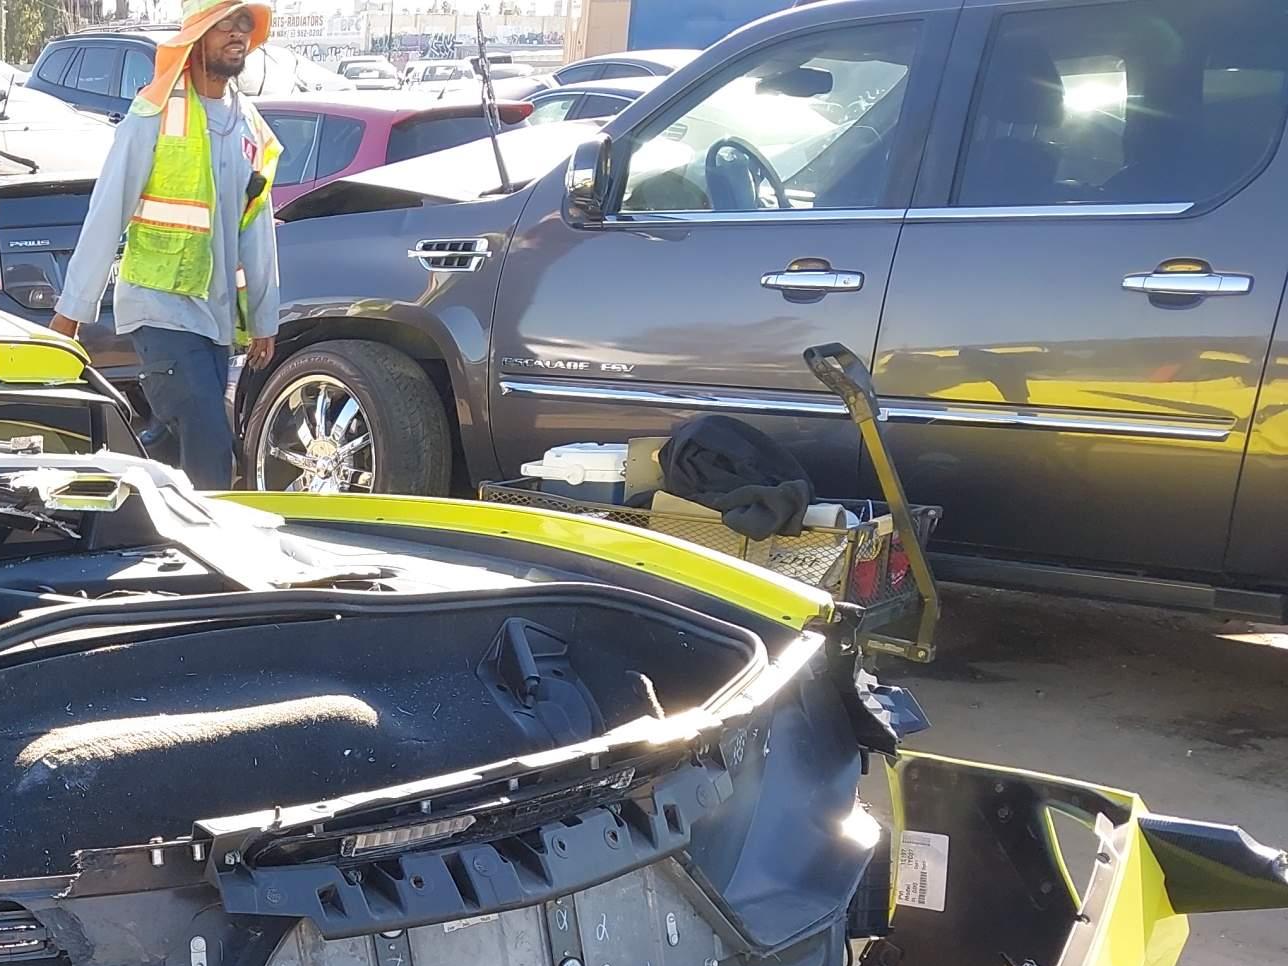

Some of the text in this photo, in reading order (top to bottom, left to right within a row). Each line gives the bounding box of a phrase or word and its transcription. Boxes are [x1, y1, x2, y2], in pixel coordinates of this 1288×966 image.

[9, 239, 50, 247] PRIUS
[501, 357, 636, 373] ESCALADE ESV
